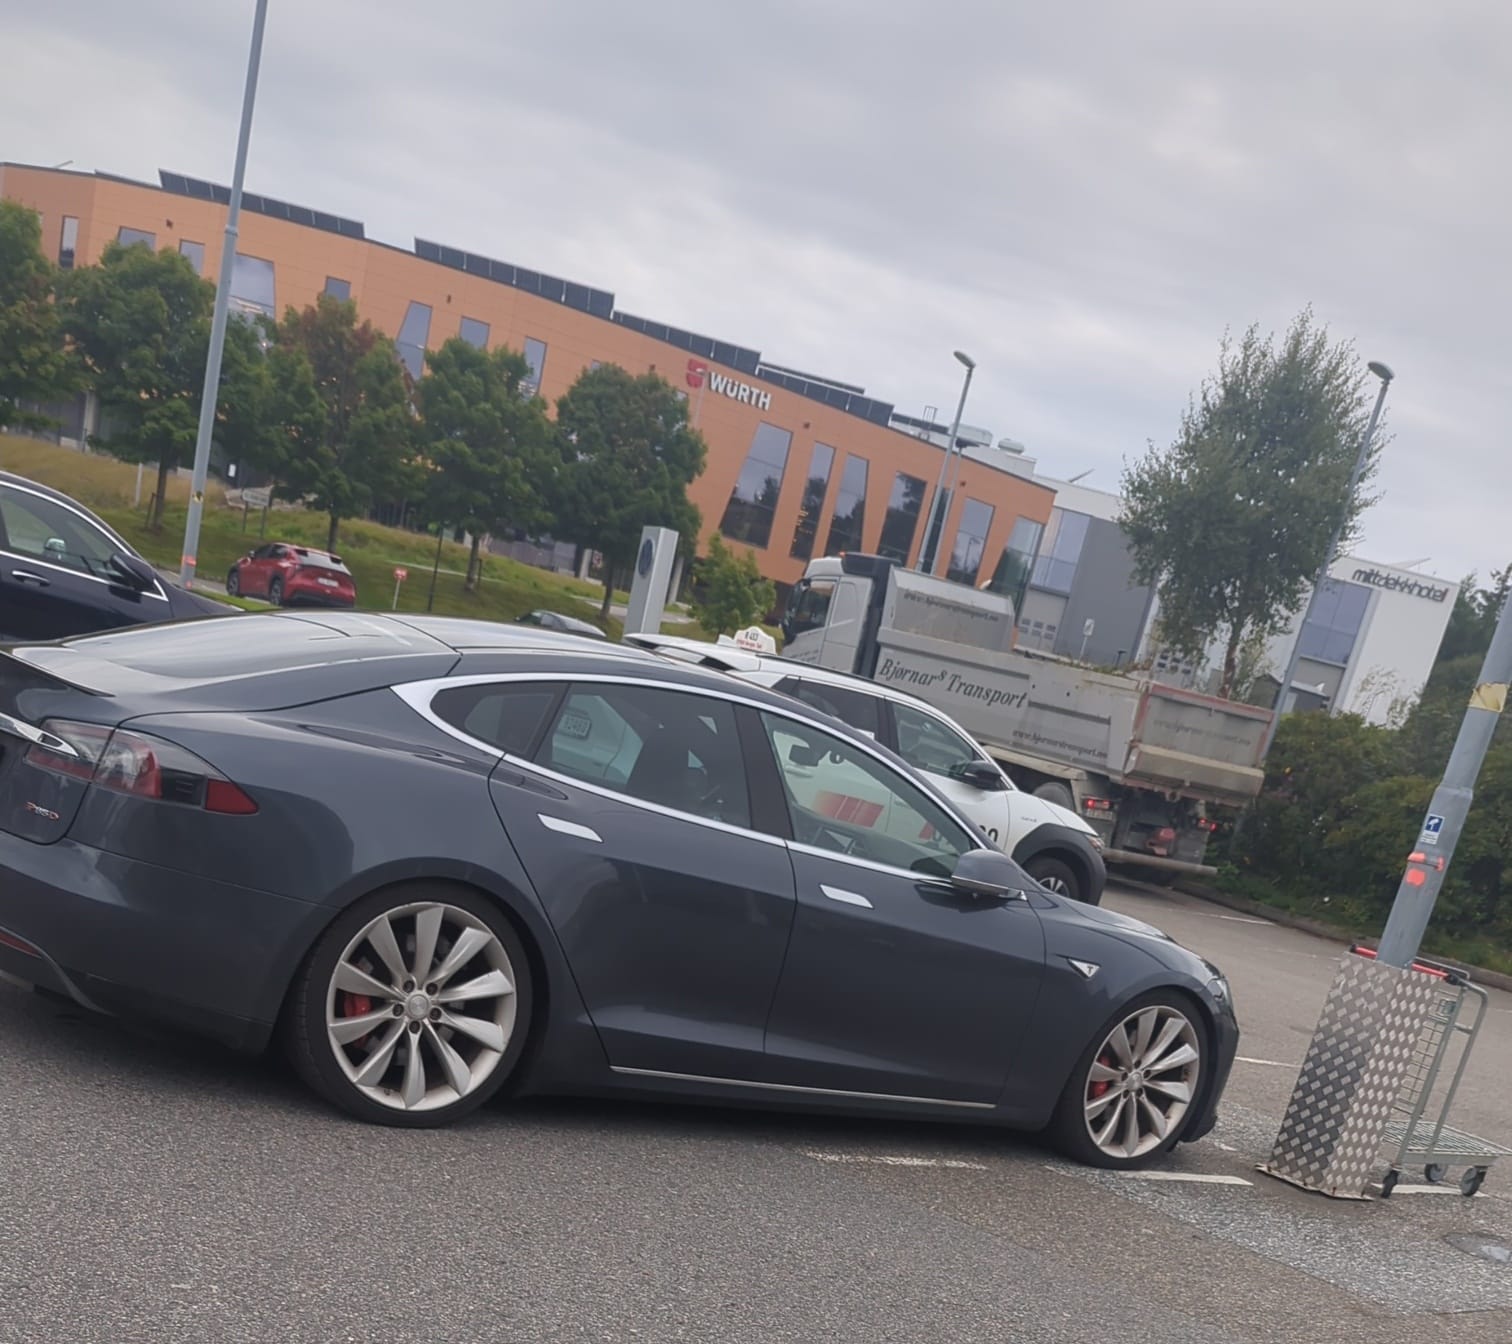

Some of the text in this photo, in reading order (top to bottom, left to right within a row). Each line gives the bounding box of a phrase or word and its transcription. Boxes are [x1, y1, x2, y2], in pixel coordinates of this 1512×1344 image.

[709, 371, 771, 411] WÜRTH
[1352, 568, 1449, 603] mittdekkhotel
[946, 673, 1028, 709] Transport
